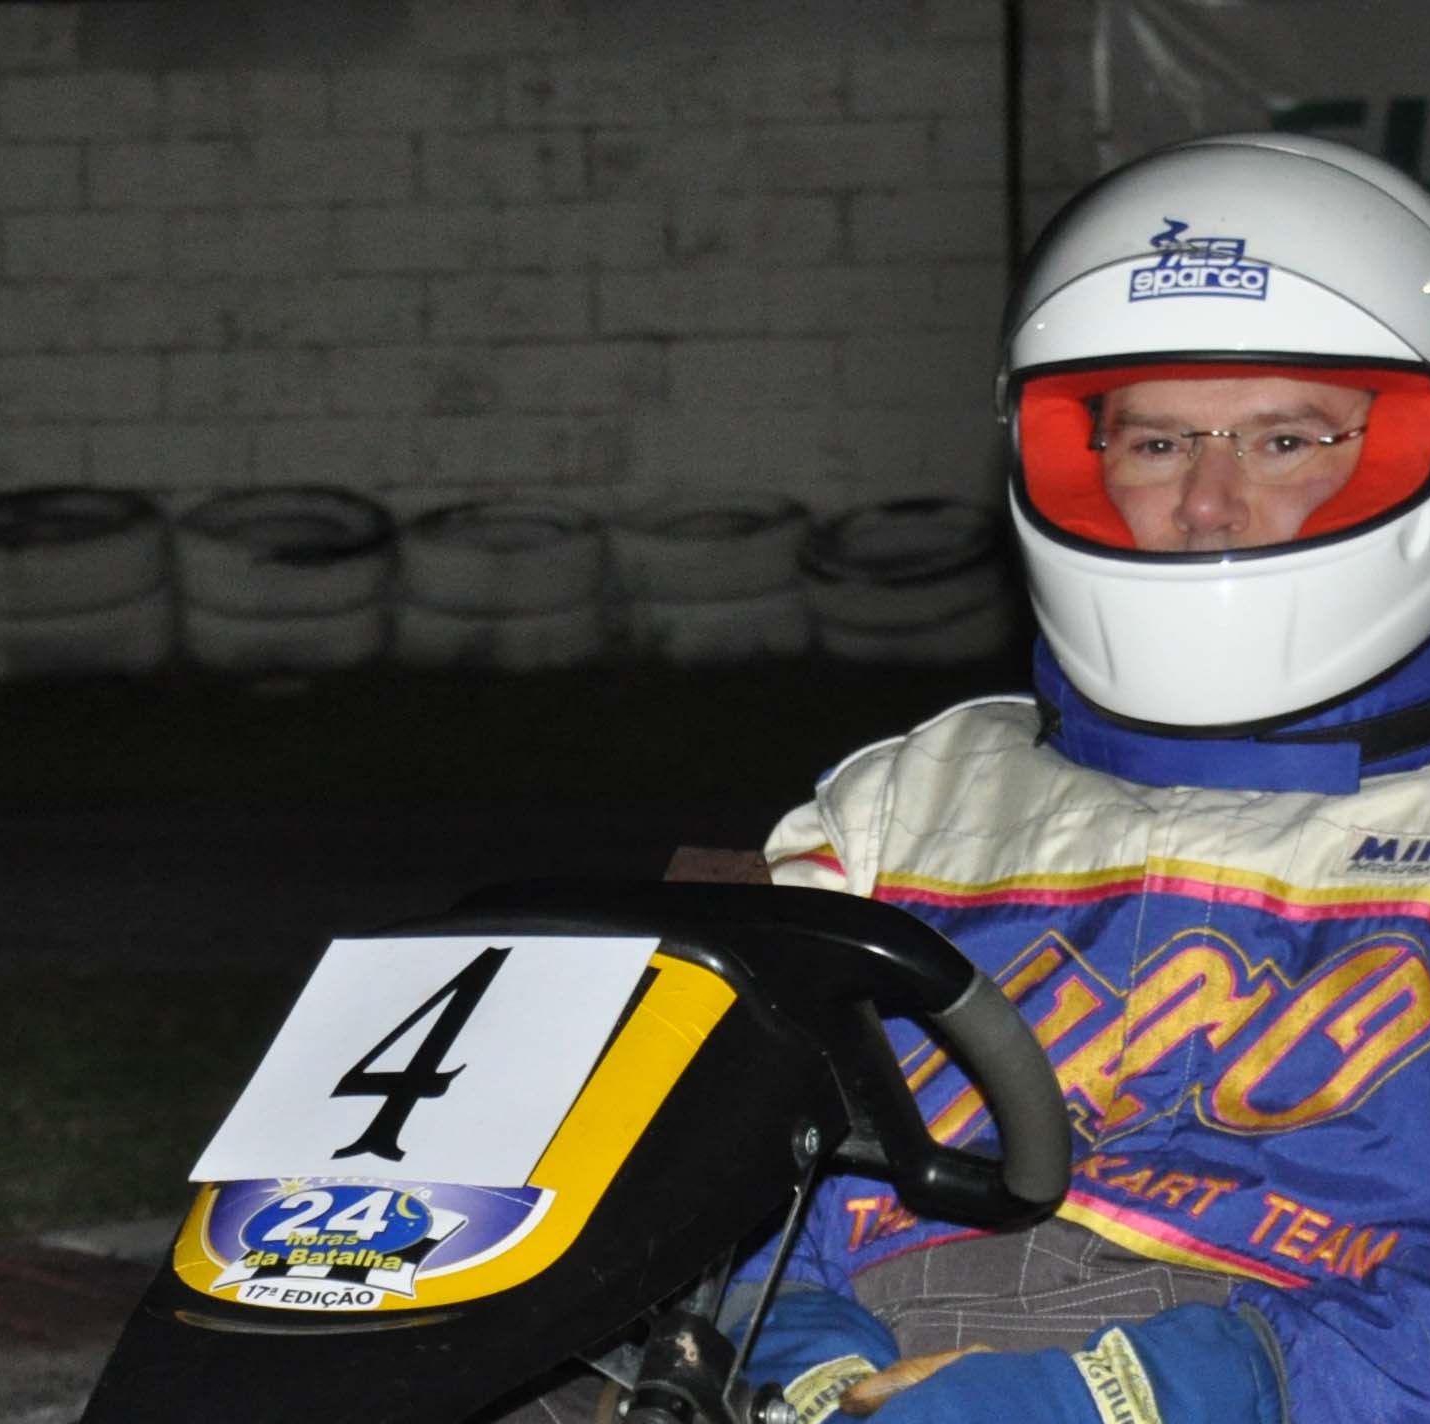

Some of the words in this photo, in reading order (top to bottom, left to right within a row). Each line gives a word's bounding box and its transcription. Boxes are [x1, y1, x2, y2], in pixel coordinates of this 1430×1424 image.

[330, 947, 513, 1161] 4
[262, 1190, 395, 1242] 24
[1071, 1154, 1239, 1219] KART
[1248, 1191, 1400, 1279] TEAM
[285, 1231, 359, 1246] horas
[244, 1250, 280, 1268] da
[286, 1248, 404, 1272] Batalha
[280, 1287, 375, 1308] EDIÇÃO
